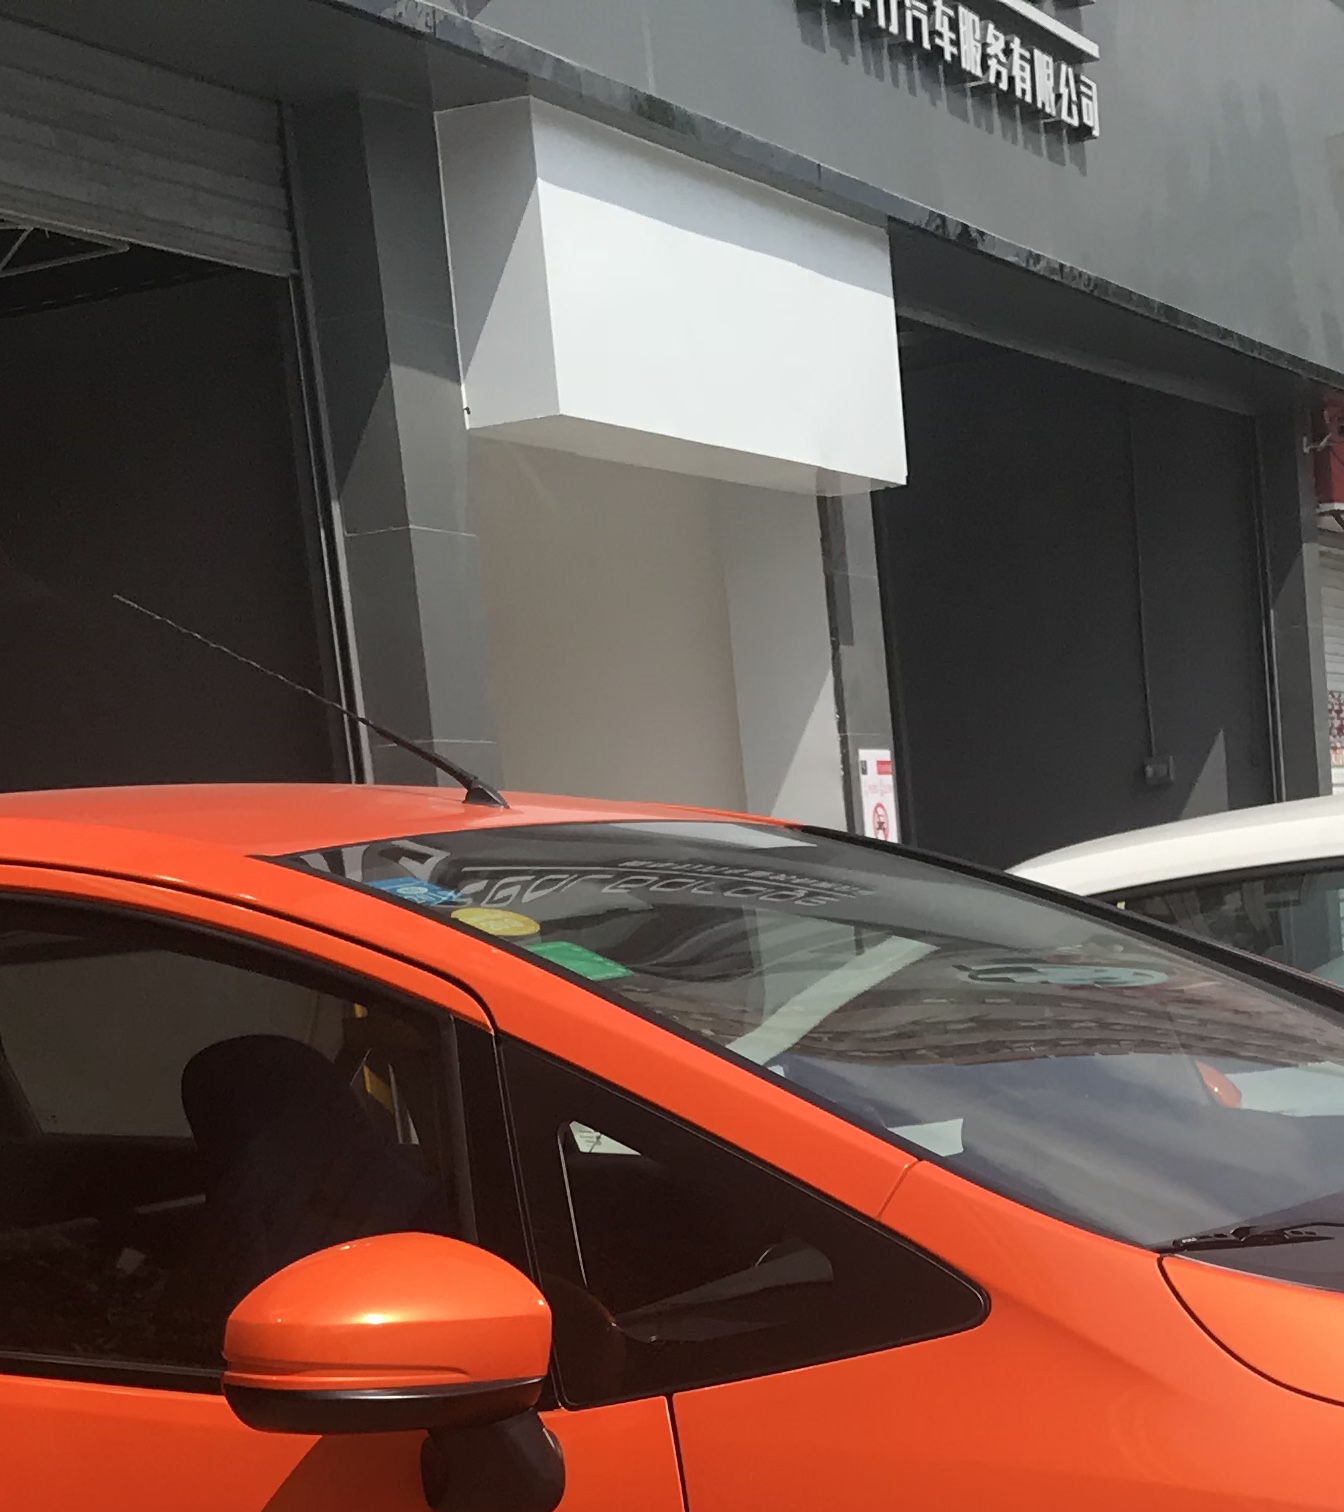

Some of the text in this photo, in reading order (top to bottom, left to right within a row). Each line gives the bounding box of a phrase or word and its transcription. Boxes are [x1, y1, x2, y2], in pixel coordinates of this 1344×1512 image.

[854, 0, 1100, 138] 汽车服务有限公司
